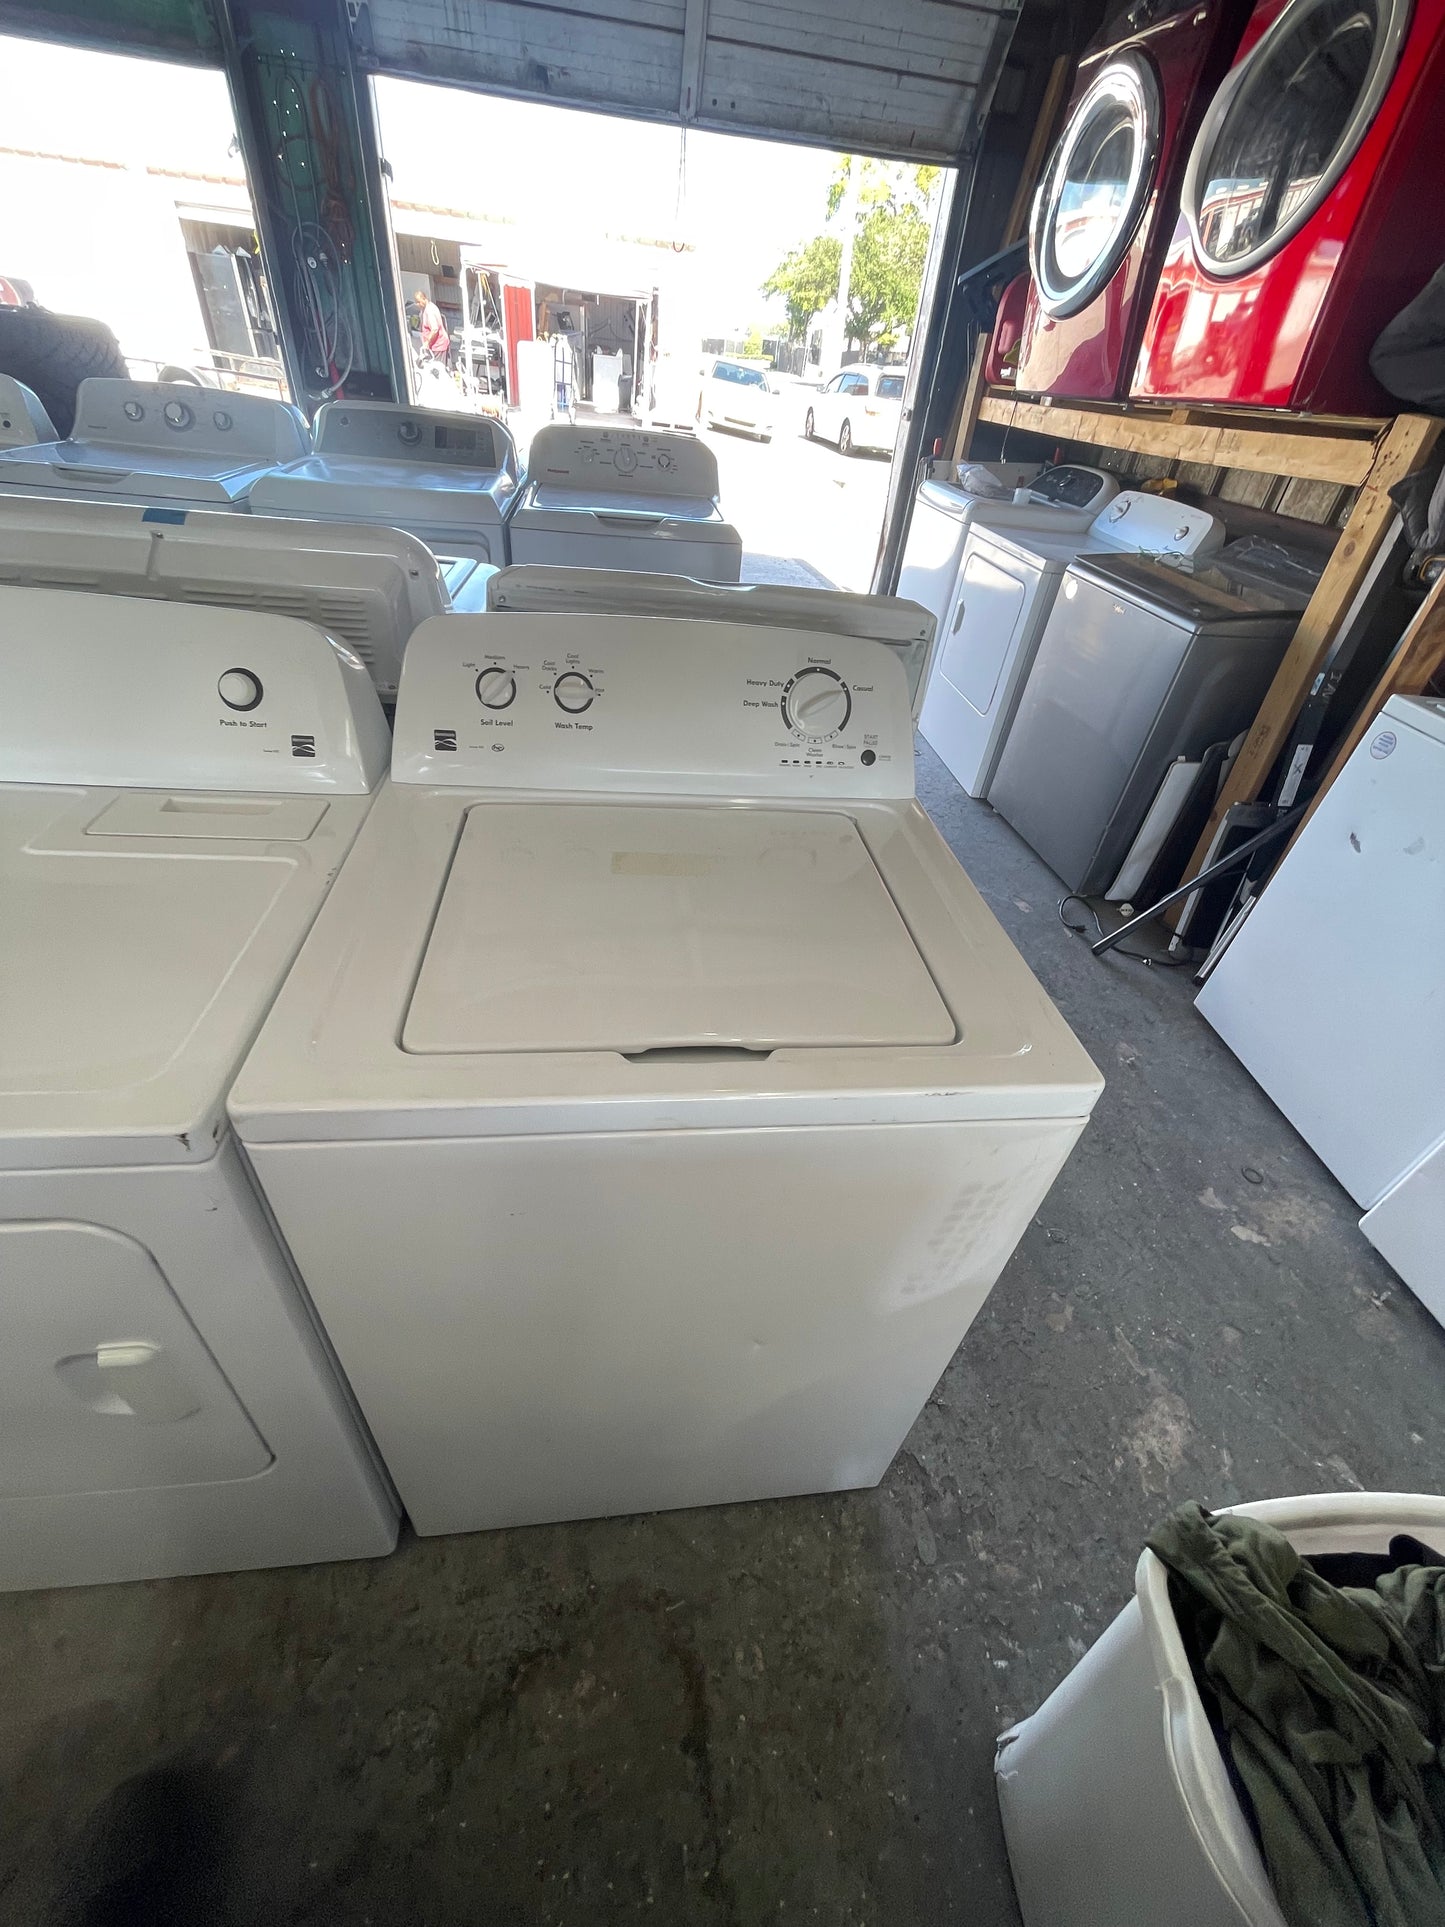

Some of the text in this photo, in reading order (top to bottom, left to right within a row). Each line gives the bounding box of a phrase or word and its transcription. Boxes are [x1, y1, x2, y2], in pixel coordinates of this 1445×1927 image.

[807, 657, 832, 665] Normal
[746, 679, 784, 688] Heavy Duty
[743, 700, 779, 708] Deep Wash
[219, 719, 238, 727] Push
[249, 720, 267, 728] Start
[480, 718, 513, 727] Soil Level
[575, 723, 593, 731] Temp
